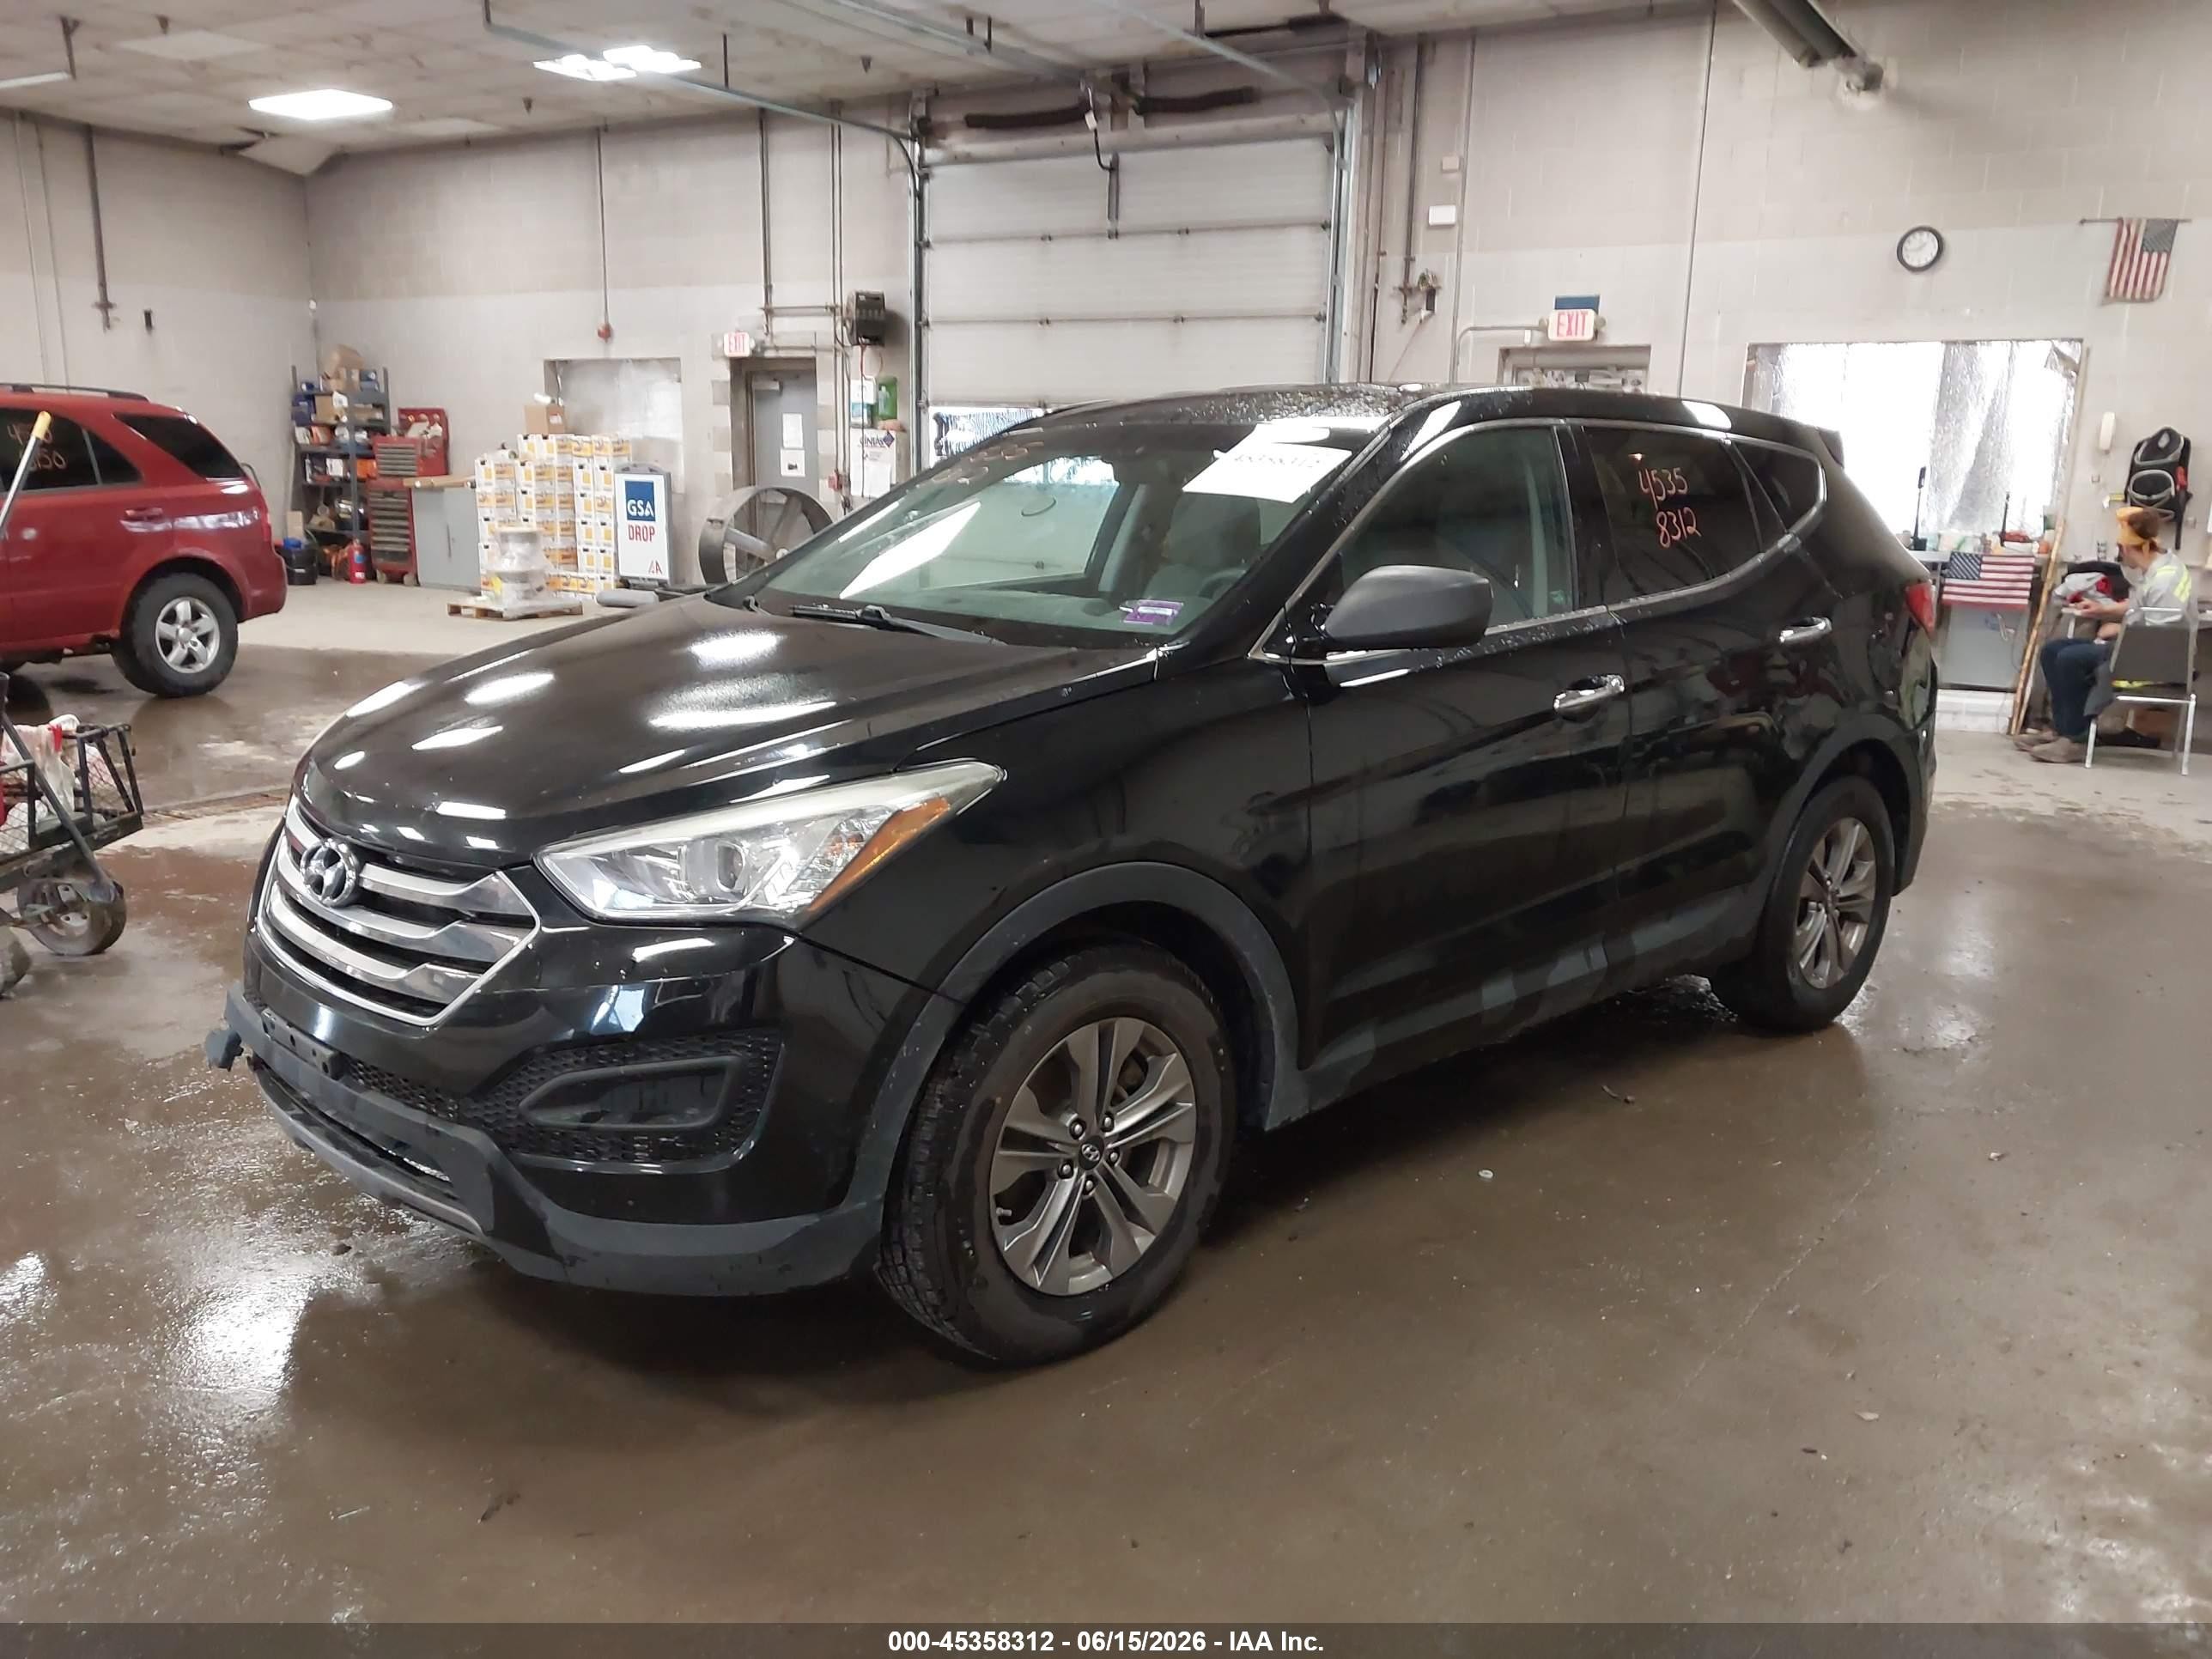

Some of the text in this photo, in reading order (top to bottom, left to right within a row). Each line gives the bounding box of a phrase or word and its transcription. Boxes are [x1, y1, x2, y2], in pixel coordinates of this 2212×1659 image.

[1557, 310, 1589, 337] EXIT
[728, 334, 745, 353] EXIT
[1638, 467, 1688, 510] 4535
[627, 500, 654, 517] GSA
[628, 525, 655, 542] DROP
[1656, 507, 1702, 548] 8312
